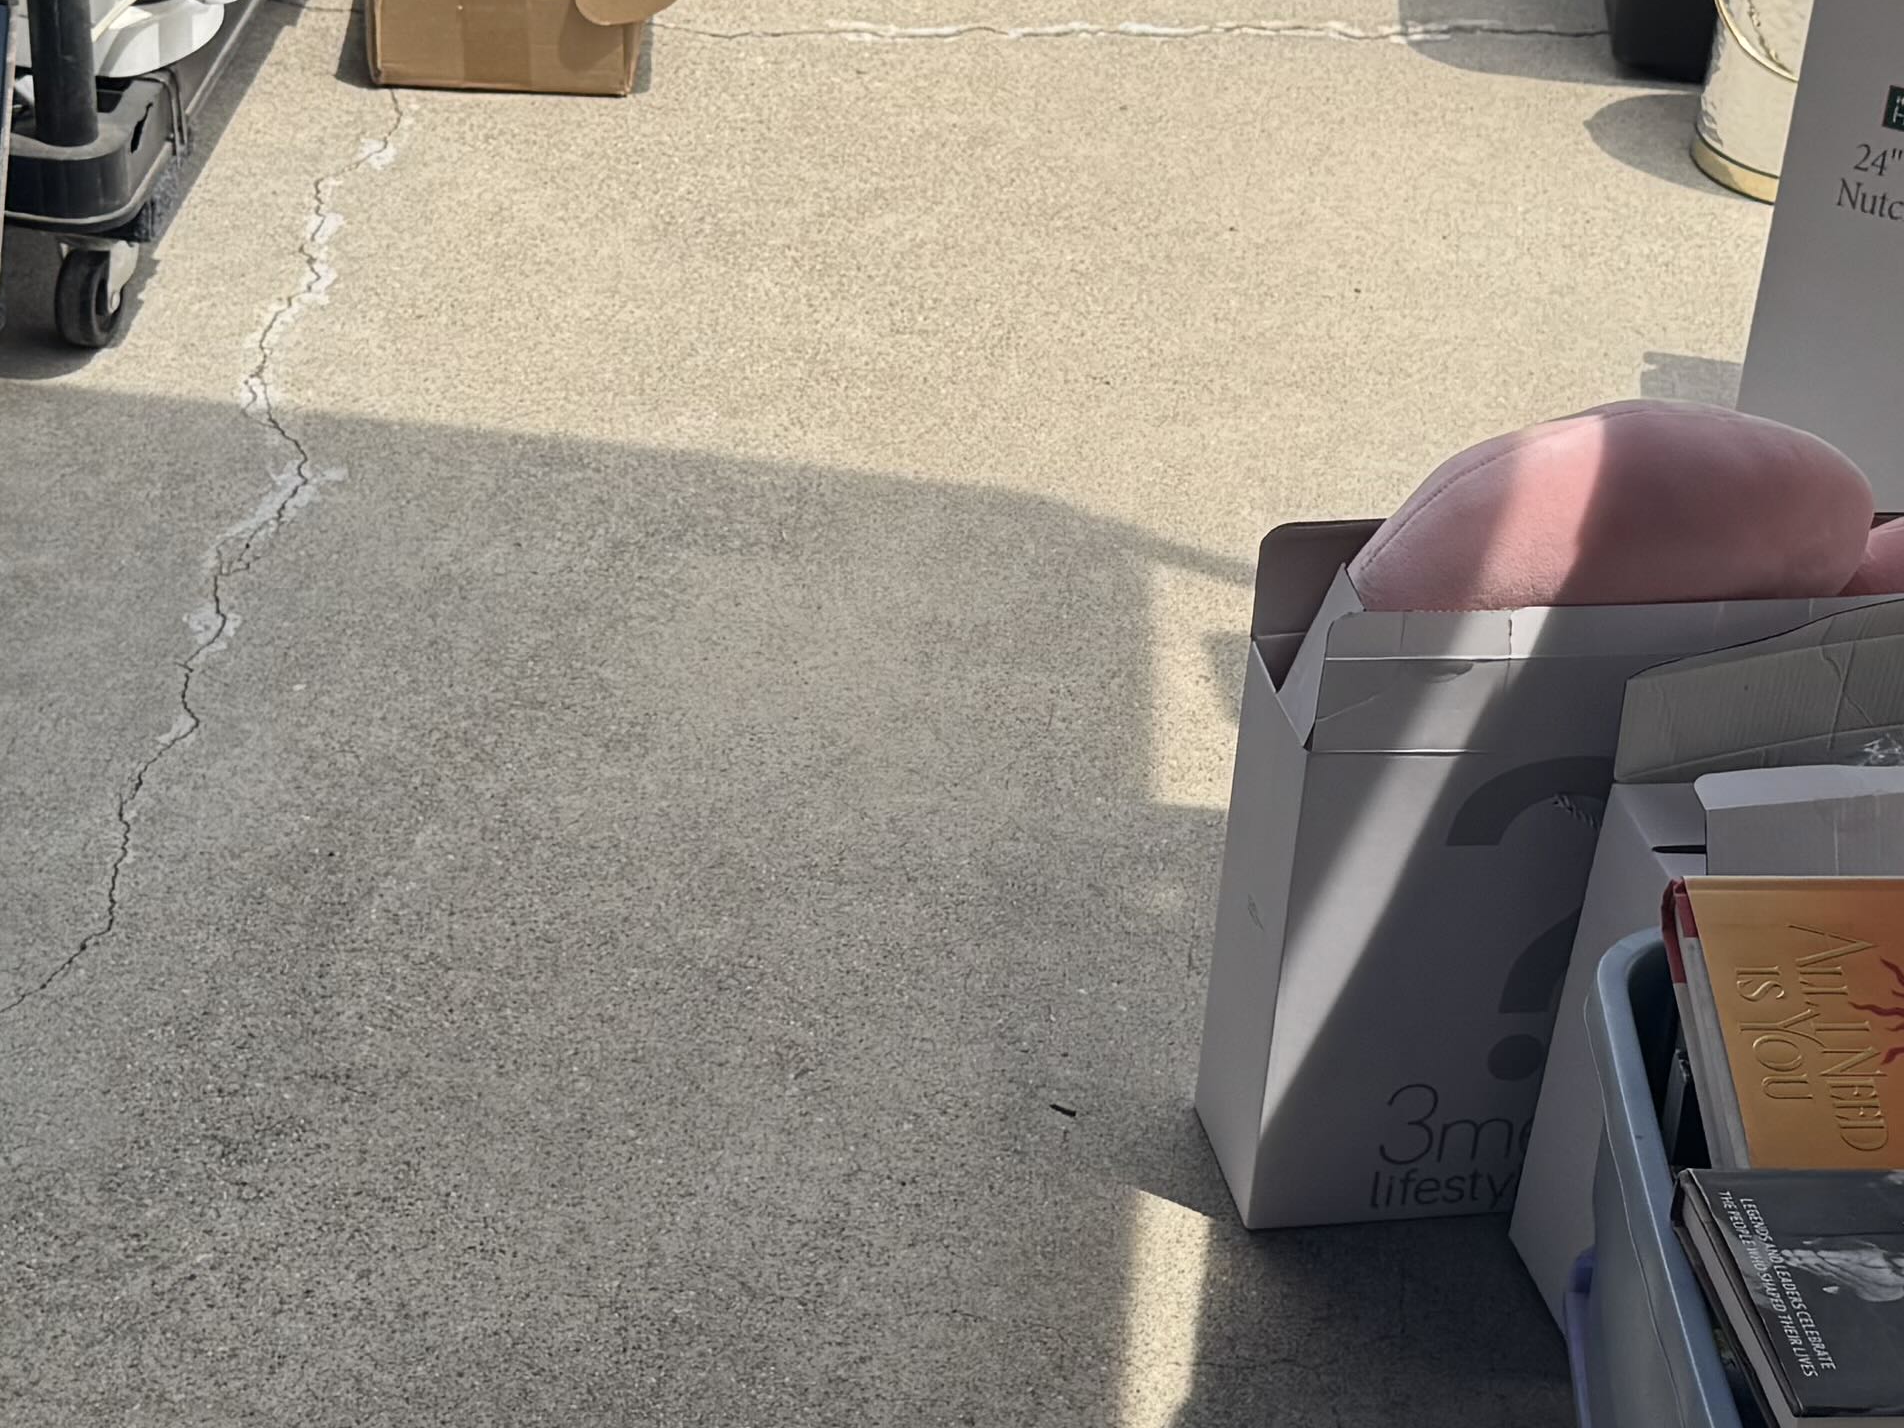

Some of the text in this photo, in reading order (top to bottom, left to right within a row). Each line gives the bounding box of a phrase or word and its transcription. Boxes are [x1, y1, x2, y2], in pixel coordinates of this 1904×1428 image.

[1853, 144, 1903, 178] 24"
[1734, 964, 1815, 1103] IS YOU
[1818, 1038, 1890, 1154] NEED
[1368, 1160, 1514, 1212] lifesty
